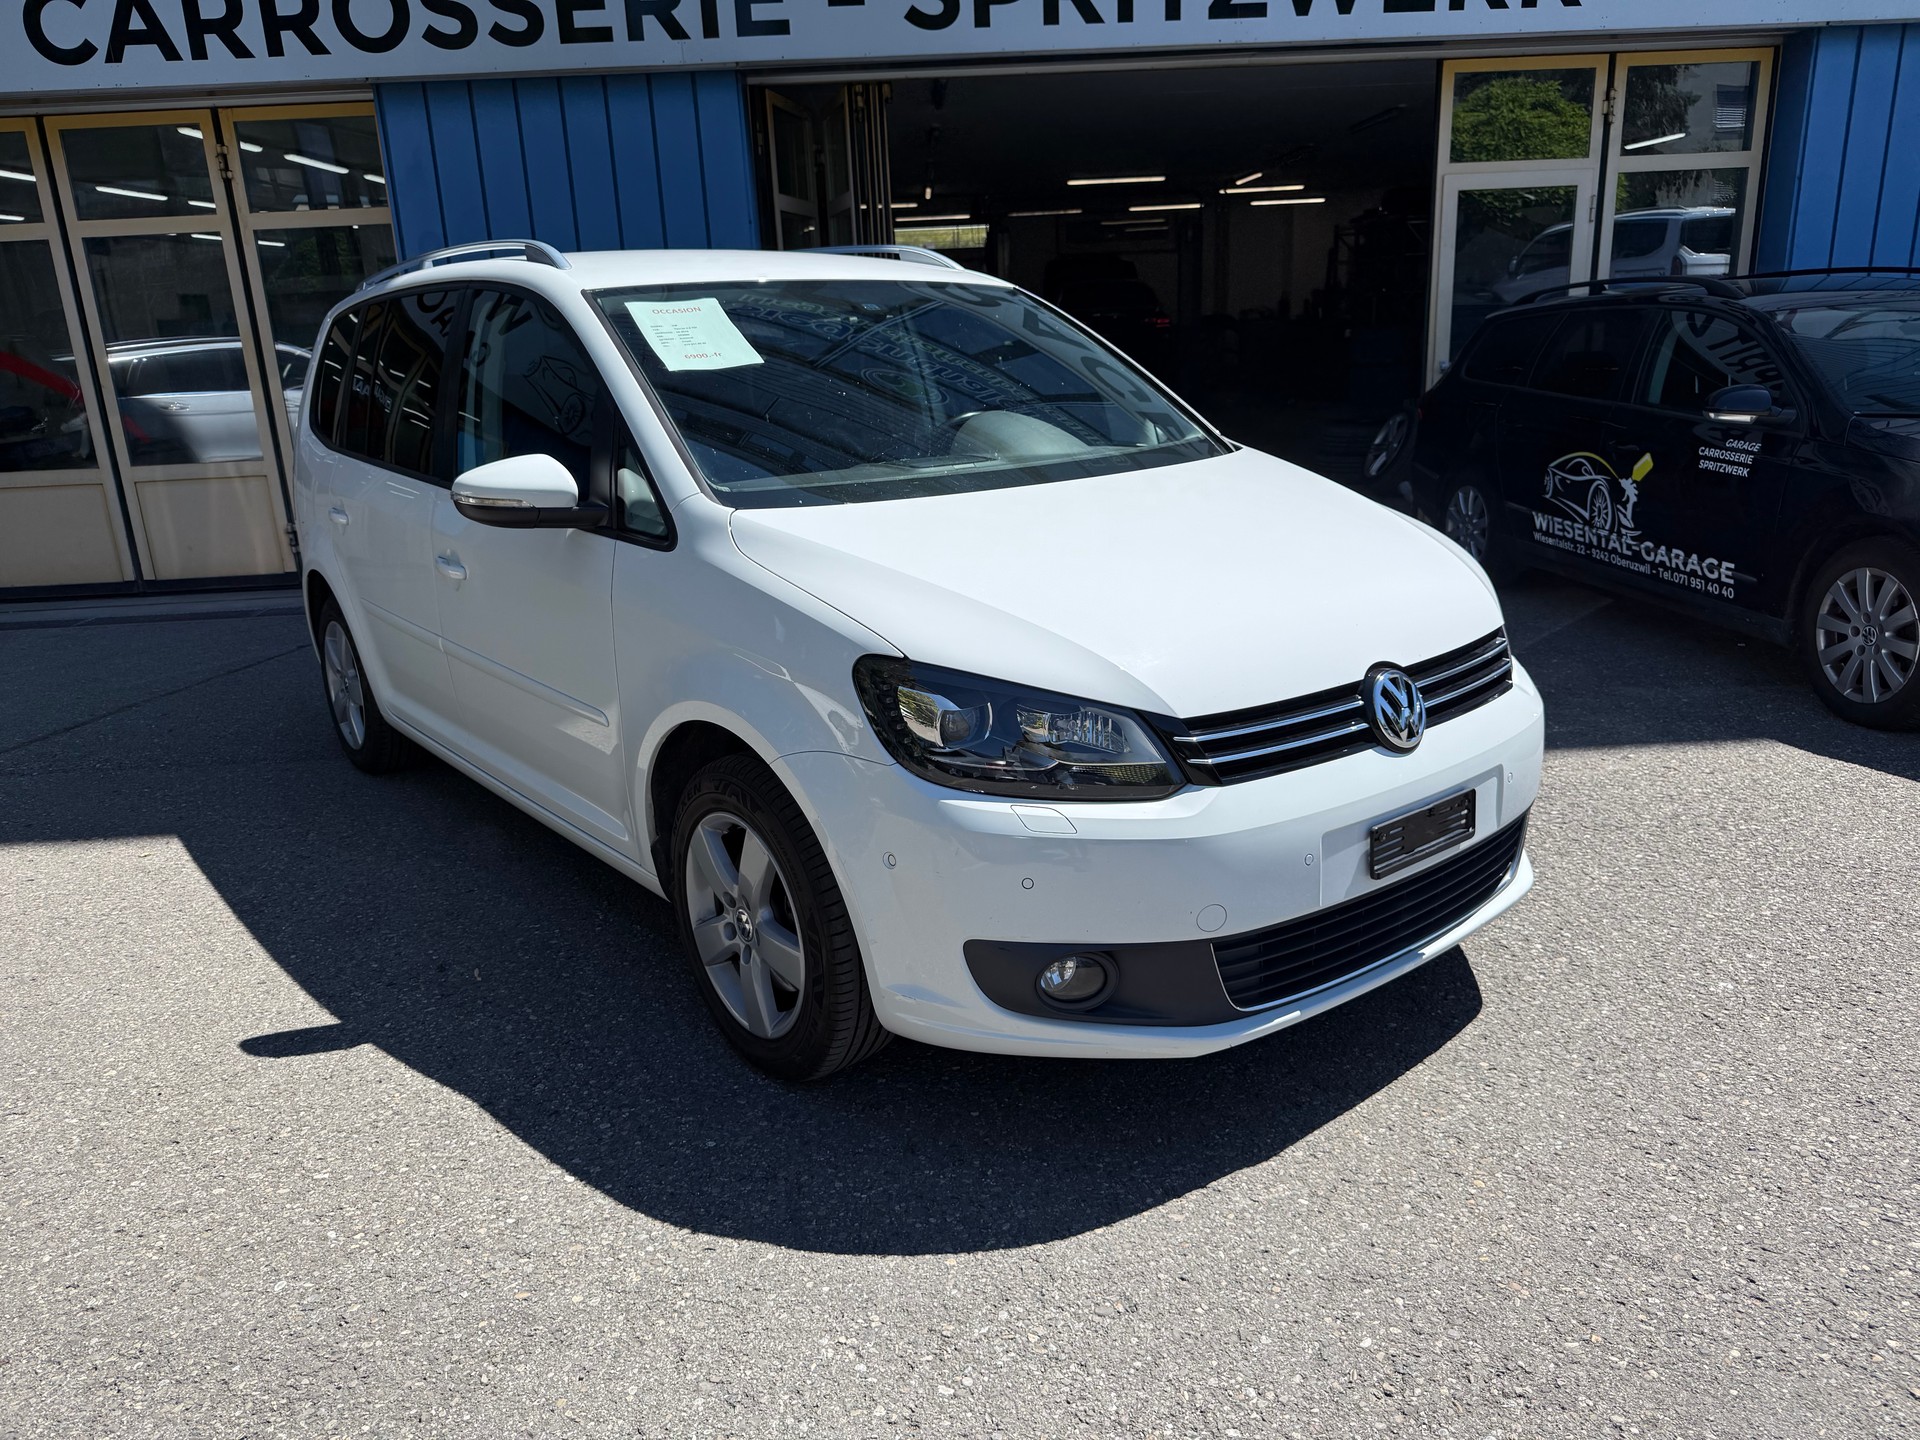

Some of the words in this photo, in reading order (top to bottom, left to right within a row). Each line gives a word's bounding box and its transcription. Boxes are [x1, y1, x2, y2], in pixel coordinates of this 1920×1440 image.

[23, 0, 791, 66] CARROSSERIE
[652, 306, 702, 315] OCCASION
[1725, 438, 1762, 452] GARAGE
[1698, 446, 1754, 465] CARROSSERIE
[1698, 459, 1750, 478] SPRITZWERK
[1532, 511, 1735, 585] WIESENTAL-GARAGE
[1533, 531, 1576, 552] Wiesentalstr.
[1576, 544, 1586, 555] 22
[1591, 548, 1609, 562] 9242
[1610, 554, 1651, 575] Oberuzwil
[1690, 577, 1705, 592] 951
[1707, 582, 1720, 595] 40
[1721, 586, 1735, 599] 40
